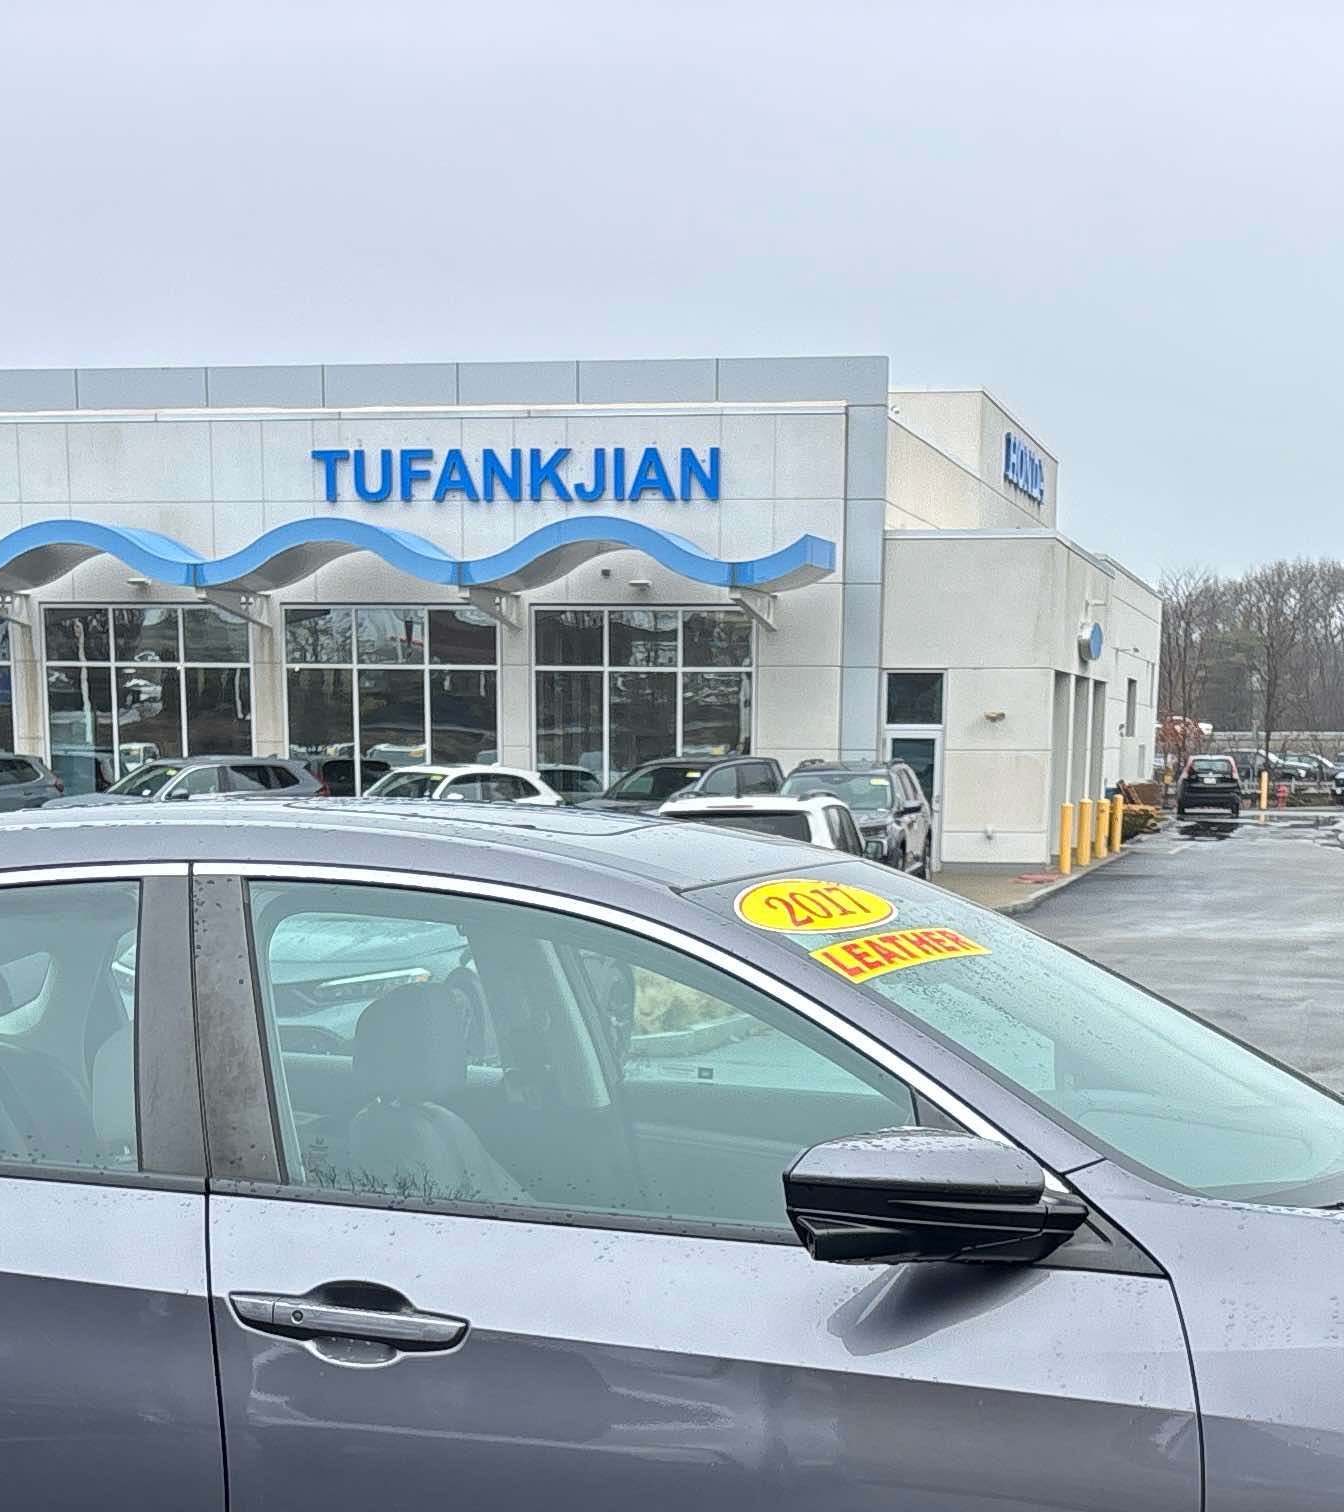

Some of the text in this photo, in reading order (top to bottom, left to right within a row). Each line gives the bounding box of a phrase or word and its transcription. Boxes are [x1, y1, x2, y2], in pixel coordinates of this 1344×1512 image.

[311, 447, 720, 503] TUFANKJIAN
[764, 887, 871, 927] 2017
[822, 929, 981, 977] LEATHER
